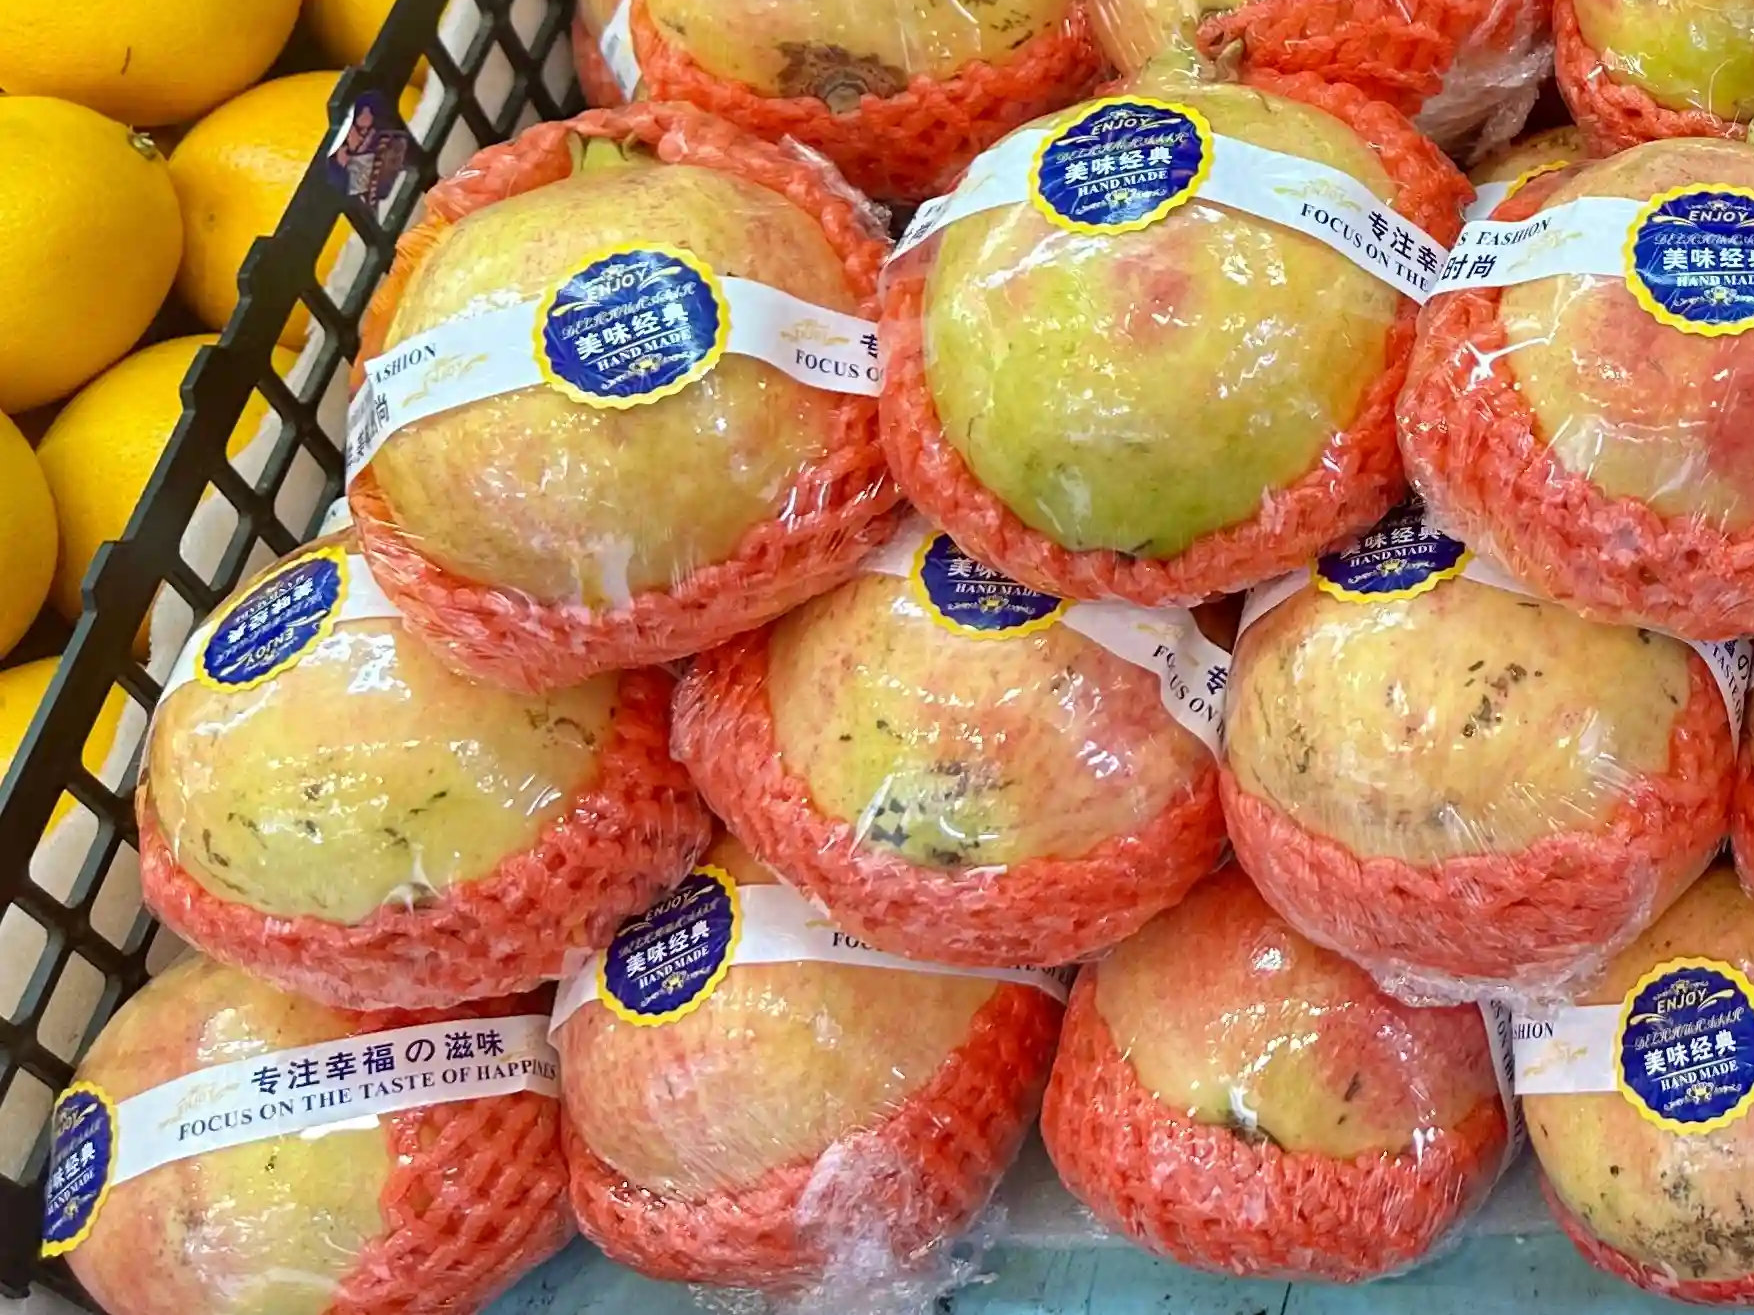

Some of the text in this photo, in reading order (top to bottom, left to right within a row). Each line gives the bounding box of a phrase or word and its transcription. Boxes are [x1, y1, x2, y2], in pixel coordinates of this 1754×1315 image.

[1091, 114, 1152, 136] ENJOY
[1065, 144, 1173, 186] 美味经典
[1078, 167, 1168, 198] HAND MADE
[1475, 216, 1553, 247] FASHION
[1688, 209, 1750, 225] ENJOY
[1301, 201, 1430, 293] FOCUS ON THE
[1367, 209, 1439, 275] 专注幸
[586, 267, 649, 303] ENJOY
[1676, 274, 1721, 288] HAND
[575, 306, 691, 359] 美味经典
[596, 327, 692, 374] HAND MADE
[795, 349, 861, 380] FOCUS
[1349, 543, 1437, 568] HAND MADE
[955, 582, 996, 595] HAND
[1189, 696, 1215, 723] ON
[644, 890, 694, 924] ENJOY
[624, 920, 711, 979] 美味经典
[637, 944, 711, 989] HAND MADE
[1655, 988, 1708, 1016] ENJOY
[251, 1028, 505, 1095] 专注幸福の滋味
[1643, 1029, 1739, 1076] 美味经典
[1659, 1058, 1739, 1094] HAND MADE
[178, 1108, 253, 1142] FOCUS
[258, 1102, 295, 1122] ON
[301, 1087, 353, 1114] THE
[362, 1071, 437, 1104] TASTE
[442, 1066, 474, 1085] OF
